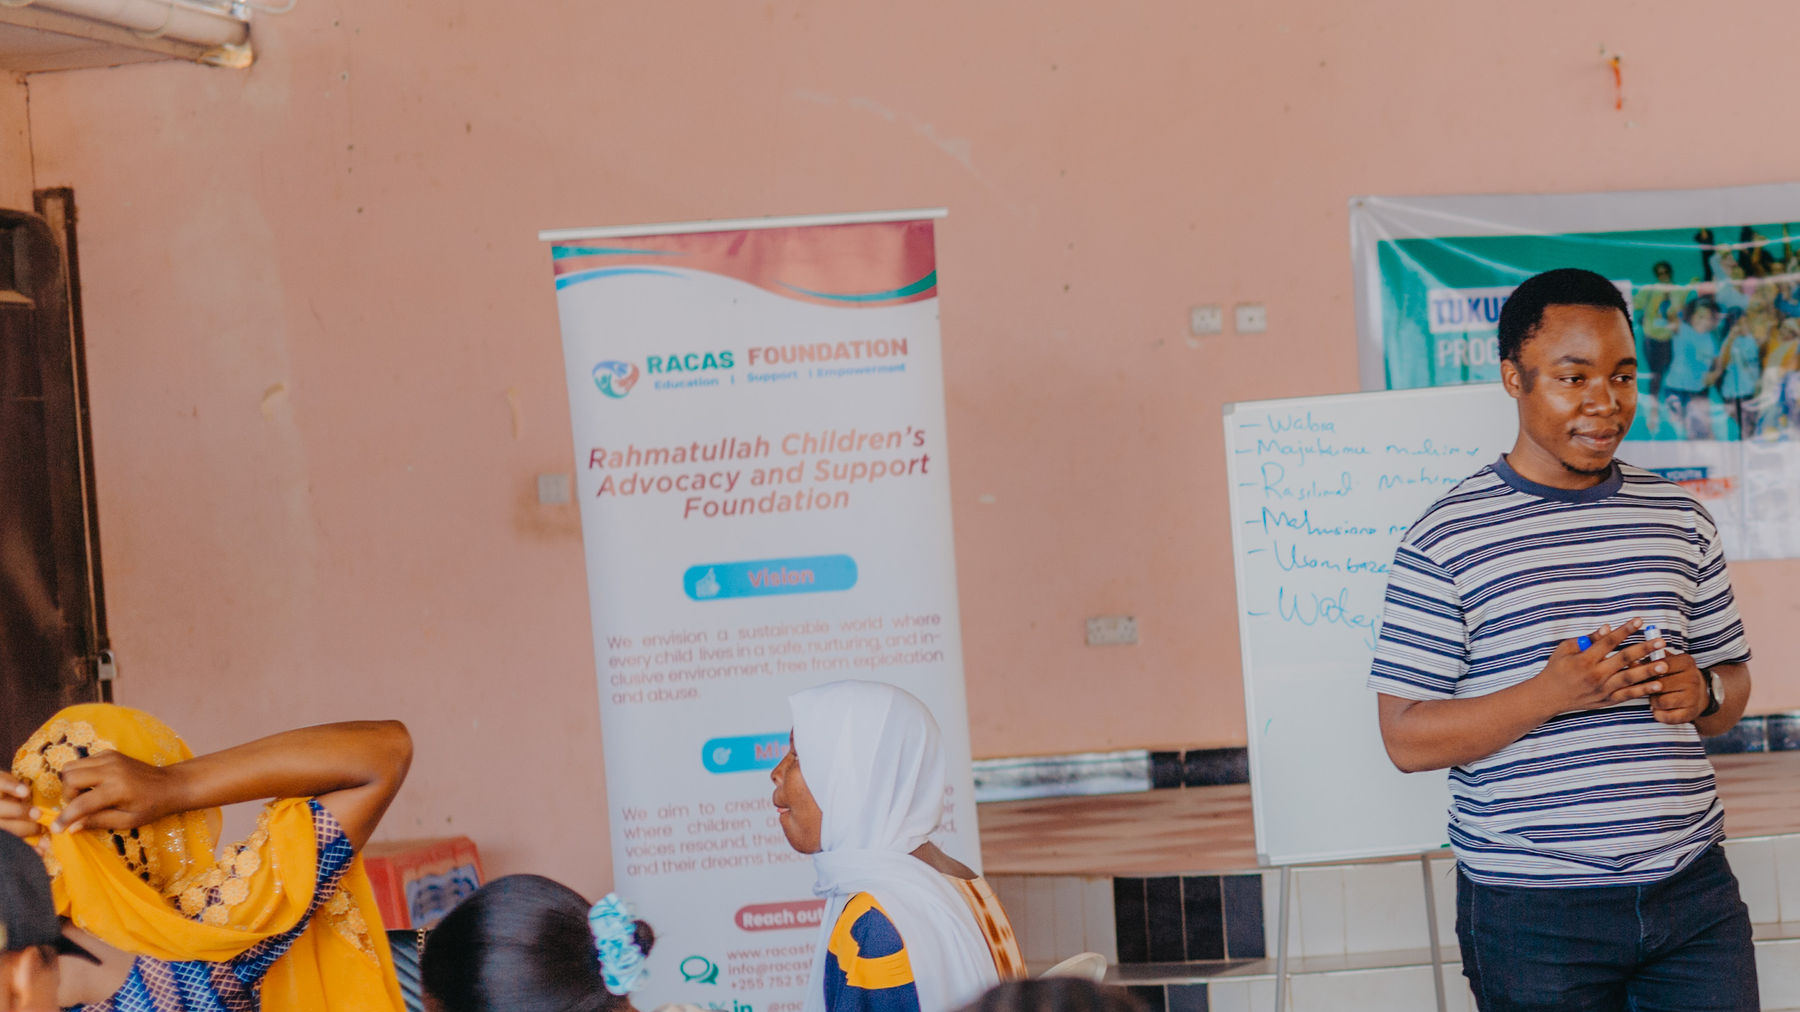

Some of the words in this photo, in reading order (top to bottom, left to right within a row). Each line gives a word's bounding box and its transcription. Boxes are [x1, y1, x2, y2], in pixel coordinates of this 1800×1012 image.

[1432, 297, 1508, 325] TUKU
[646, 351, 735, 375] RACAS
[748, 337, 909, 366] FOUNDATION
[654, 376, 719, 390] Education
[747, 370, 798, 384] Support
[816, 363, 906, 378] Empowerment
[589, 435, 770, 469] Rahmatullah
[781, 426, 925, 456] Children's
[596, 470, 740, 497] Advocacy
[751, 461, 804, 487] and
[814, 453, 930, 485] Support
[683, 488, 850, 519] Foundation
[748, 566, 815, 588] Vision
[607, 635, 632, 649] We
[642, 630, 707, 648] envision
[717, 629, 729, 642] a
[738, 620, 830, 640] sustainable
[840, 616, 883, 633] world
[892, 613, 941, 629] where
[609, 654, 650, 669] every
[655, 649, 693, 665] child
[699, 646, 734, 661] lives
[737, 643, 750, 657] in
[754, 644, 765, 657] a
[885, 632, 917, 647] and
[921, 630, 941, 645] in-
[610, 670, 664, 687] clusive
[668, 661, 773, 682] environment,
[777, 659, 807, 673] free
[811, 656, 849, 671] from
[853, 649, 943, 672] exploitation
[612, 688, 643, 705] and
[622, 807, 648, 821] We
[657, 803, 689, 819] aim
[699, 802, 715, 816] to
[623, 825, 672, 840] where
[687, 816, 751, 834] children
[625, 842, 675, 858] voices
[680, 834, 747, 853] resound,
[627, 860, 658, 877] and
[662, 857, 696, 873] their
[701, 851, 763, 871] dreams
[742, 908, 794, 928] Reach
[797, 907, 824, 923] out
[731, 977, 764, 991] +255
[768, 975, 792, 988] 752
